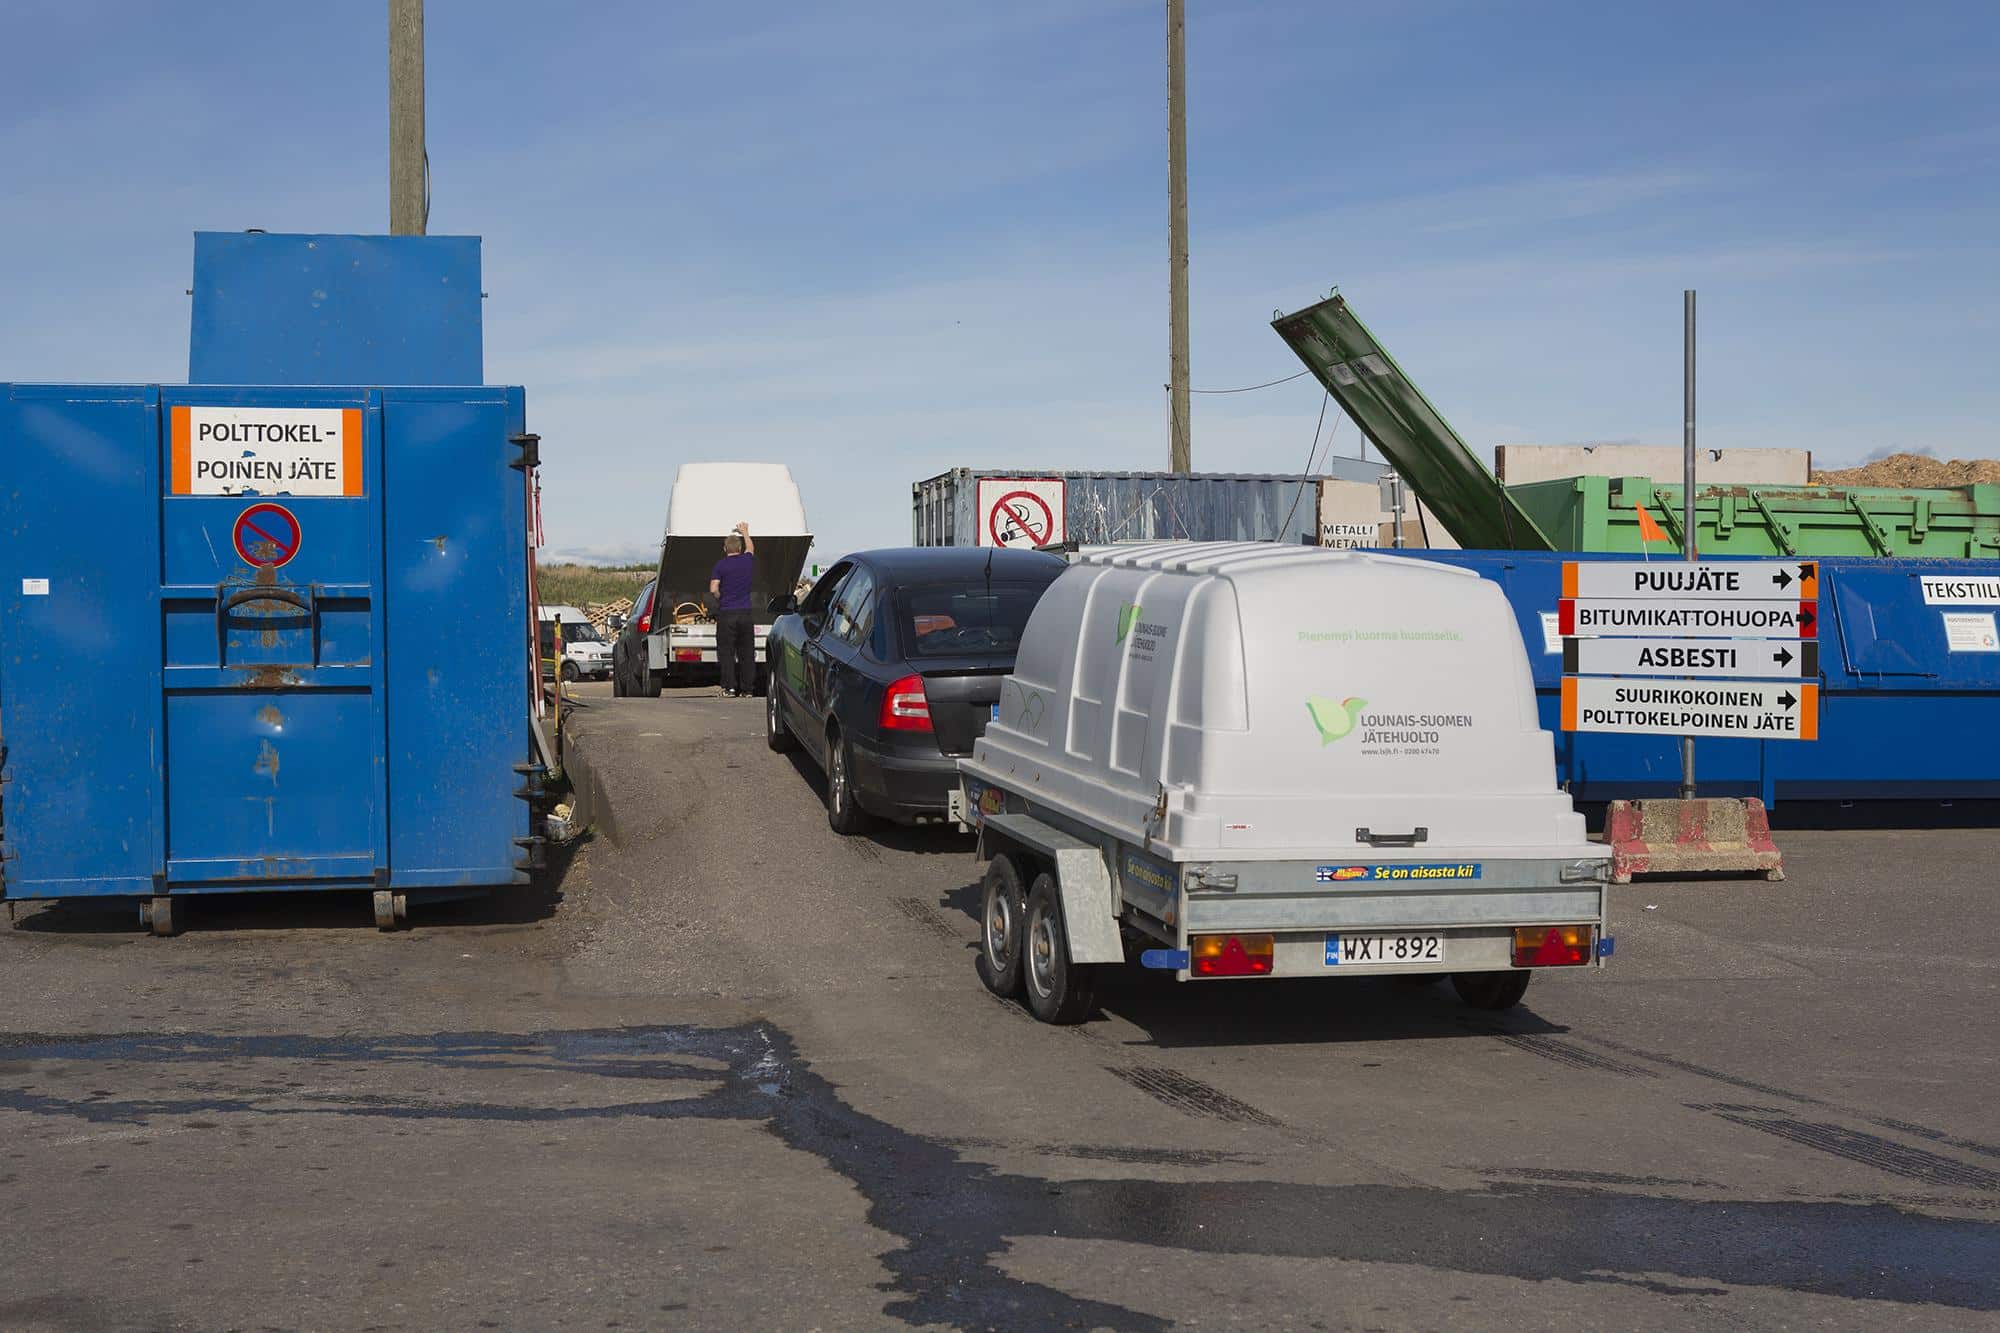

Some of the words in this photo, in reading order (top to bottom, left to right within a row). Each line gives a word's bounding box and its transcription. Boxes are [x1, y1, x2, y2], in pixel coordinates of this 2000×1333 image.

[199, 423, 336, 443] POLTTOKEL-
[197, 460, 282, 480] POINEN
[288, 457, 336, 480] JÄTE
[1323, 524, 1373, 535] METALLI
[1634, 567, 1740, 592] PUUJÄTE
[1579, 608, 1795, 628] BITUMIKATTOHUOPA
[1638, 647, 1737, 668] ASBESTI
[1615, 688, 1763, 707] SUURIKOKOINEN
[1361, 714, 1473, 727] LOUNAIS-SUOMEN
[1583, 709, 1748, 729] POLTTOKELPOINEN
[1753, 713, 1795, 731] JÄTE
[1361, 728, 1439, 743] JÄTEHUOLTO
[1375, 866, 1391, 879] Se
[1392, 869, 1409, 879] on
[1411, 866, 1455, 878] aisasta
[1457, 865, 1474, 877] kii
